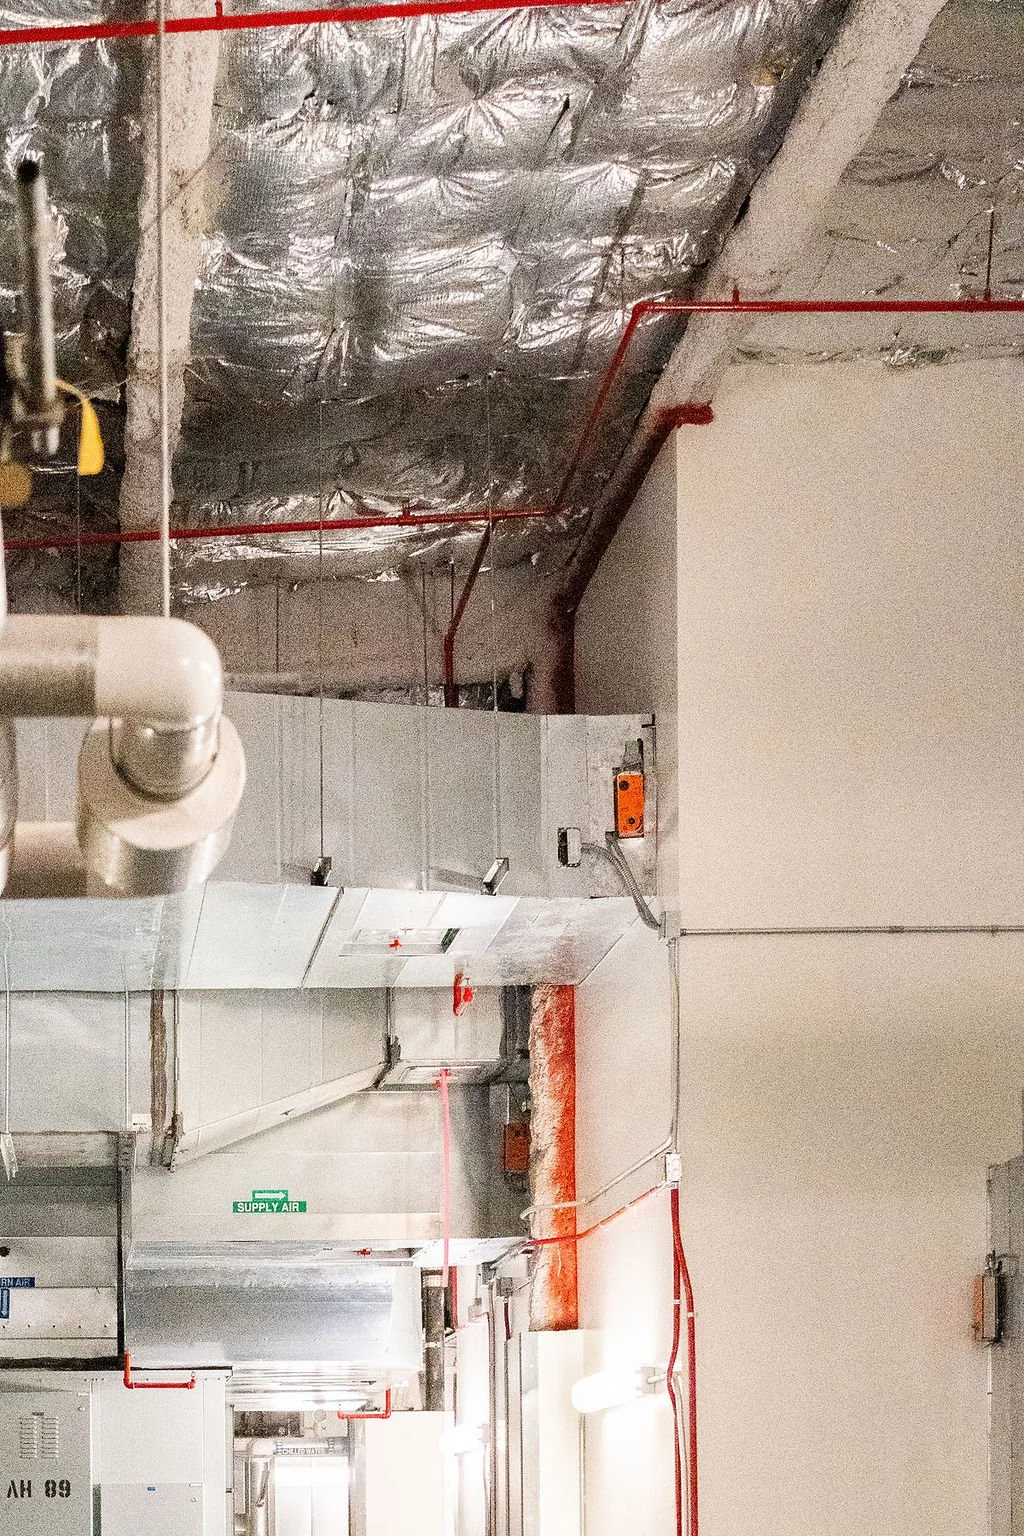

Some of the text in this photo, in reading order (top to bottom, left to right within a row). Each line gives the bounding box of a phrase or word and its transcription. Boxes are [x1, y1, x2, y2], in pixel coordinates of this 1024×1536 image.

[237, 1202, 299, 1212] SUPPLY AIR
[15, 1278, 31, 1287] AIR
[7, 1480, 70, 1498] AH 89
